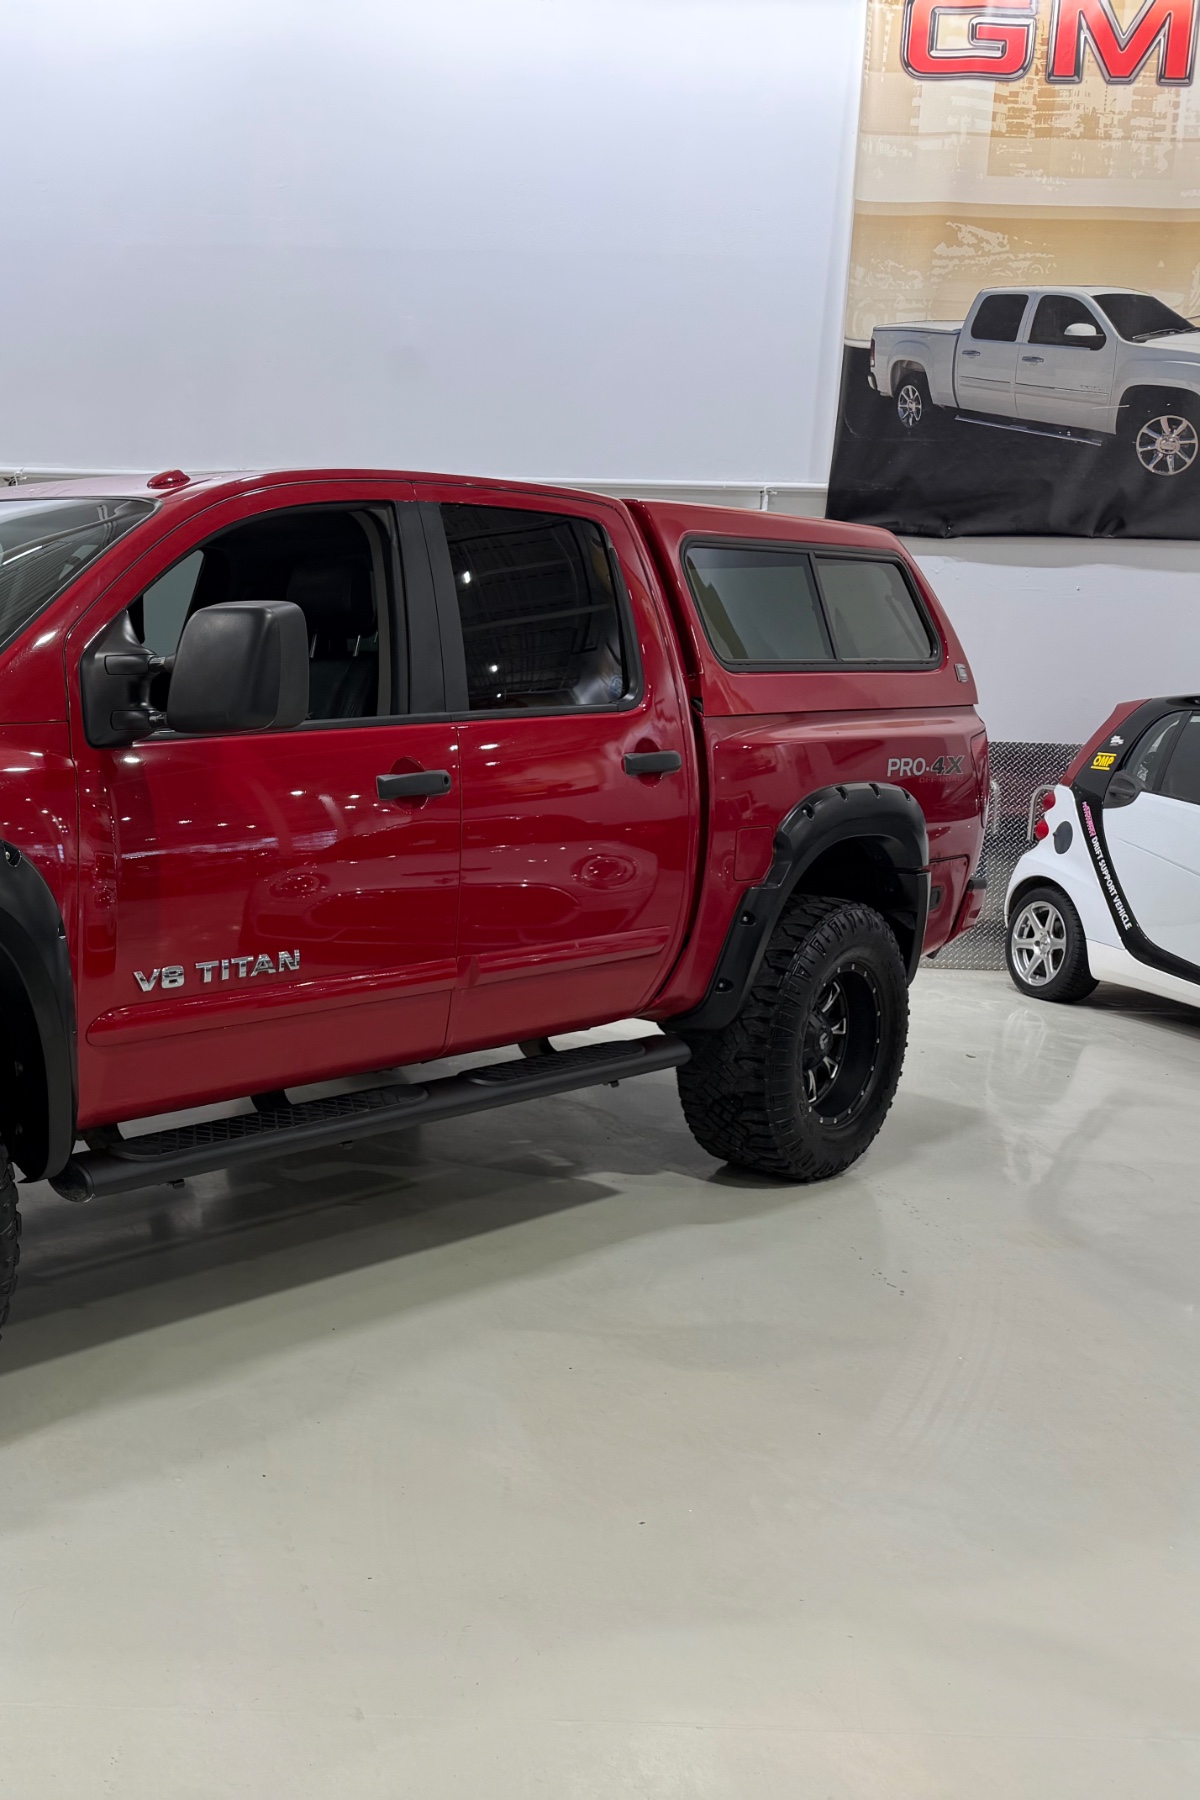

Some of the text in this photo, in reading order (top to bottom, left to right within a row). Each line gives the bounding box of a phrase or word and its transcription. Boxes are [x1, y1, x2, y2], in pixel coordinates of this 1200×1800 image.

[1093, 755, 1115, 767] OMP
[1091, 835, 1133, 931] DRIFT SUPPORT VEHICLE
[133, 949, 301, 992] V8 TITAN
